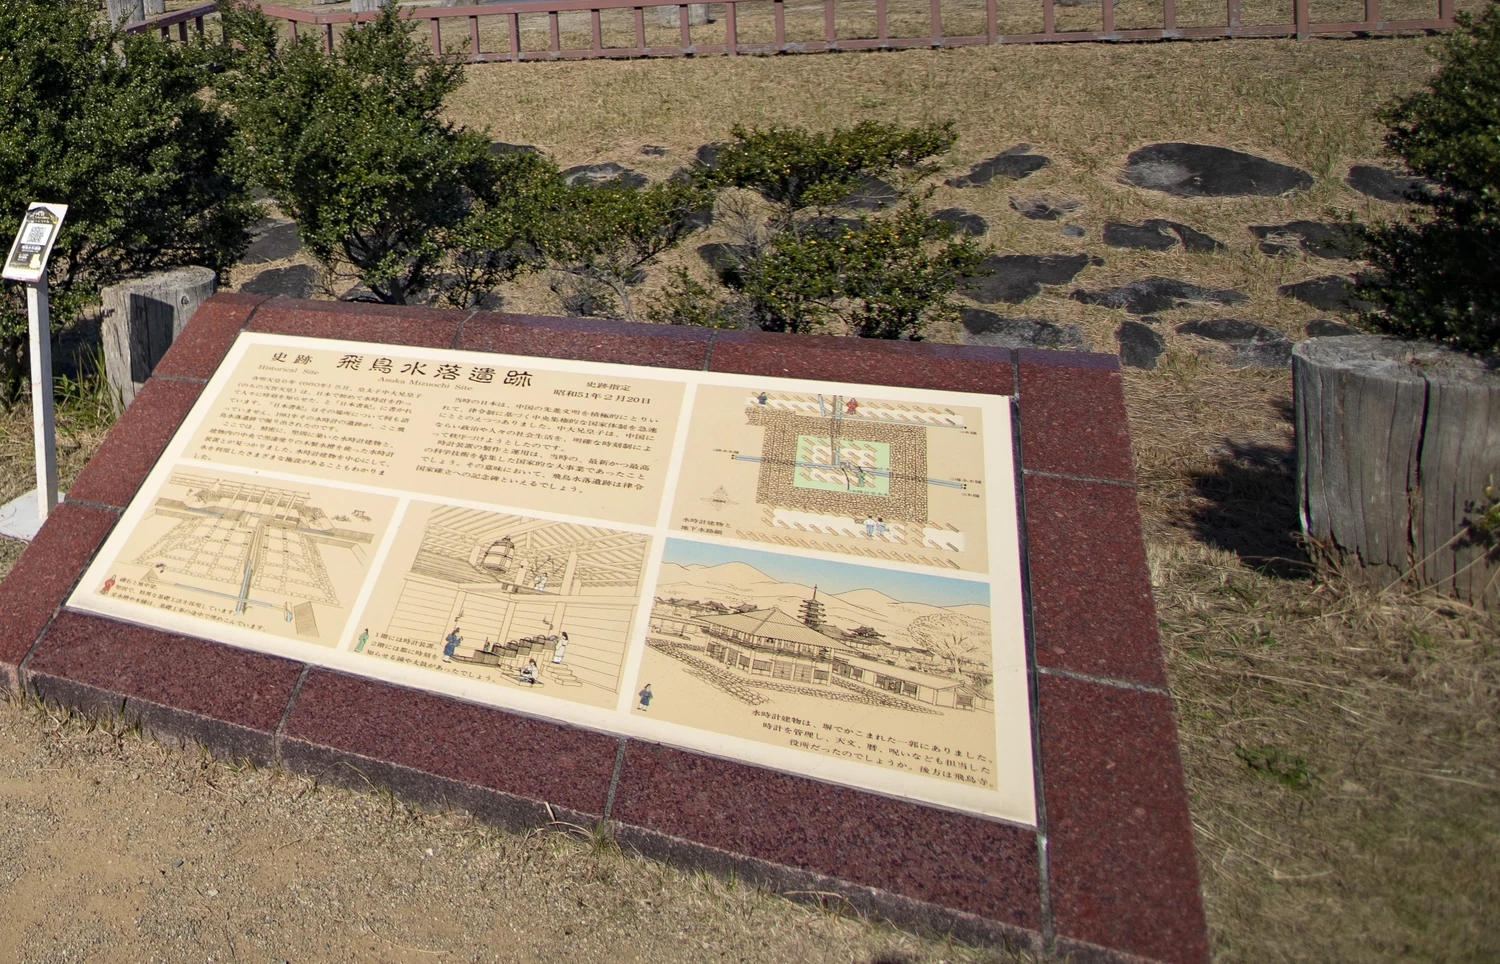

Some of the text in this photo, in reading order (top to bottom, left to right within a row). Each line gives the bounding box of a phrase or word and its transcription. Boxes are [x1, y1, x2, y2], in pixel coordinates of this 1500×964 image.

[270, 350, 313, 366] 史跡
[257, 363, 298, 373] Historical
[335, 353, 533, 387] 飛鳥水落遺跡
[376, 375, 473, 391] Asuka Mizuochi Site
[585, 380, 631, 392] 史跡指定
[681, 516, 732, 529] 水時計建物と
